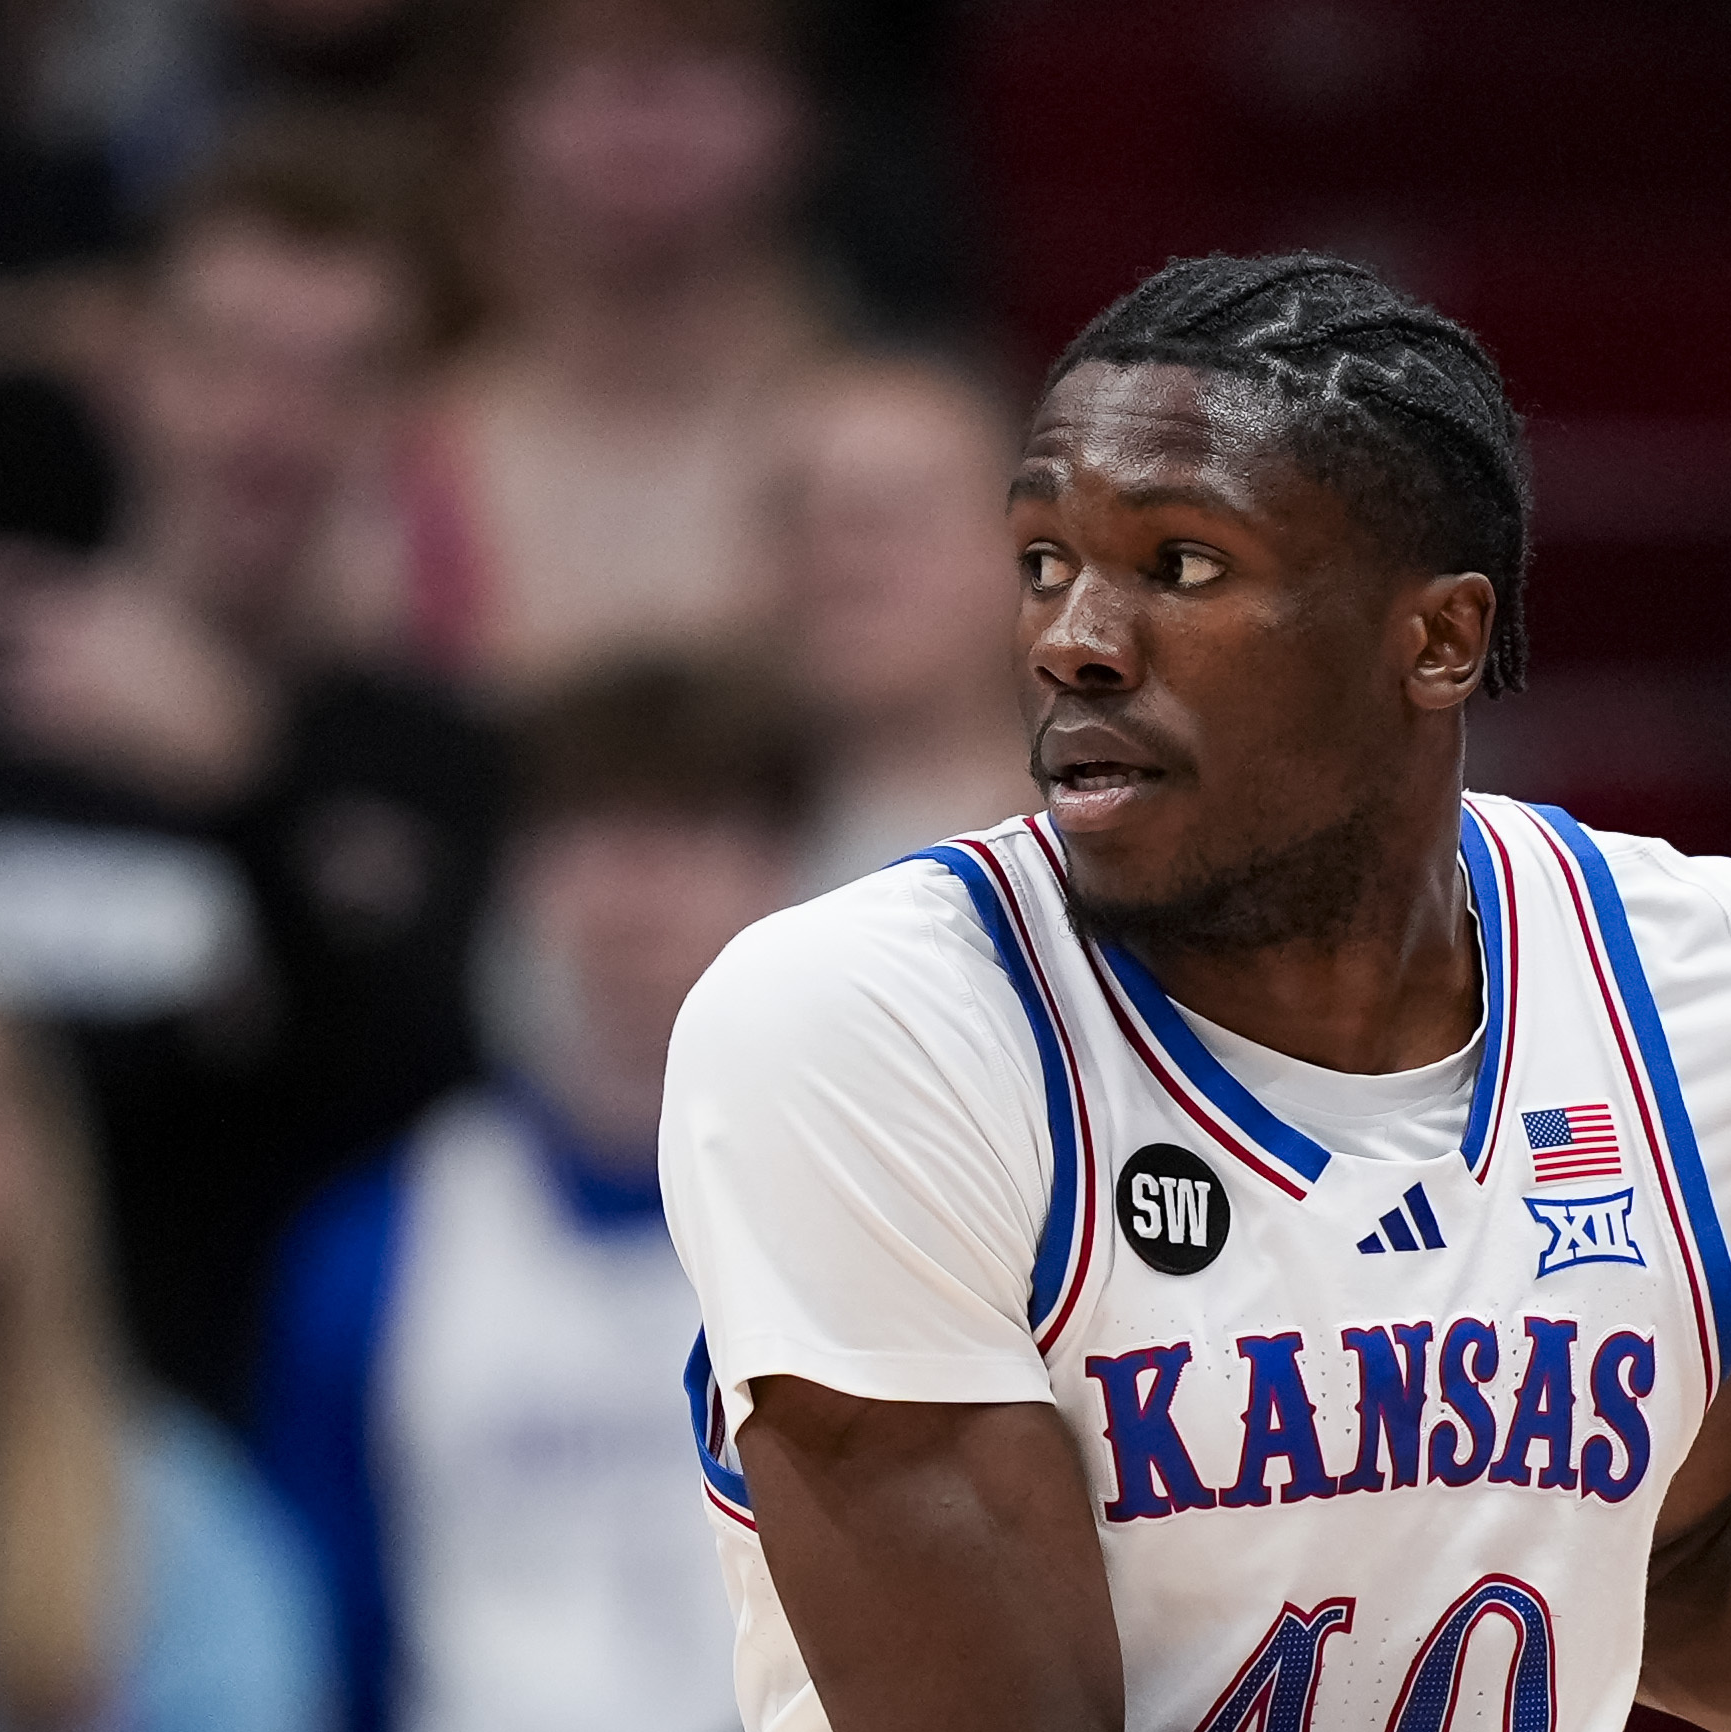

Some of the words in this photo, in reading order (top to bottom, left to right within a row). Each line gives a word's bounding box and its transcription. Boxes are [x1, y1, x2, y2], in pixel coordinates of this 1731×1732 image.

[1131, 1172, 1212, 1248] SW
[1521, 1186, 1647, 1280] XII
[1086, 1316, 1657, 1523] KANSAS
